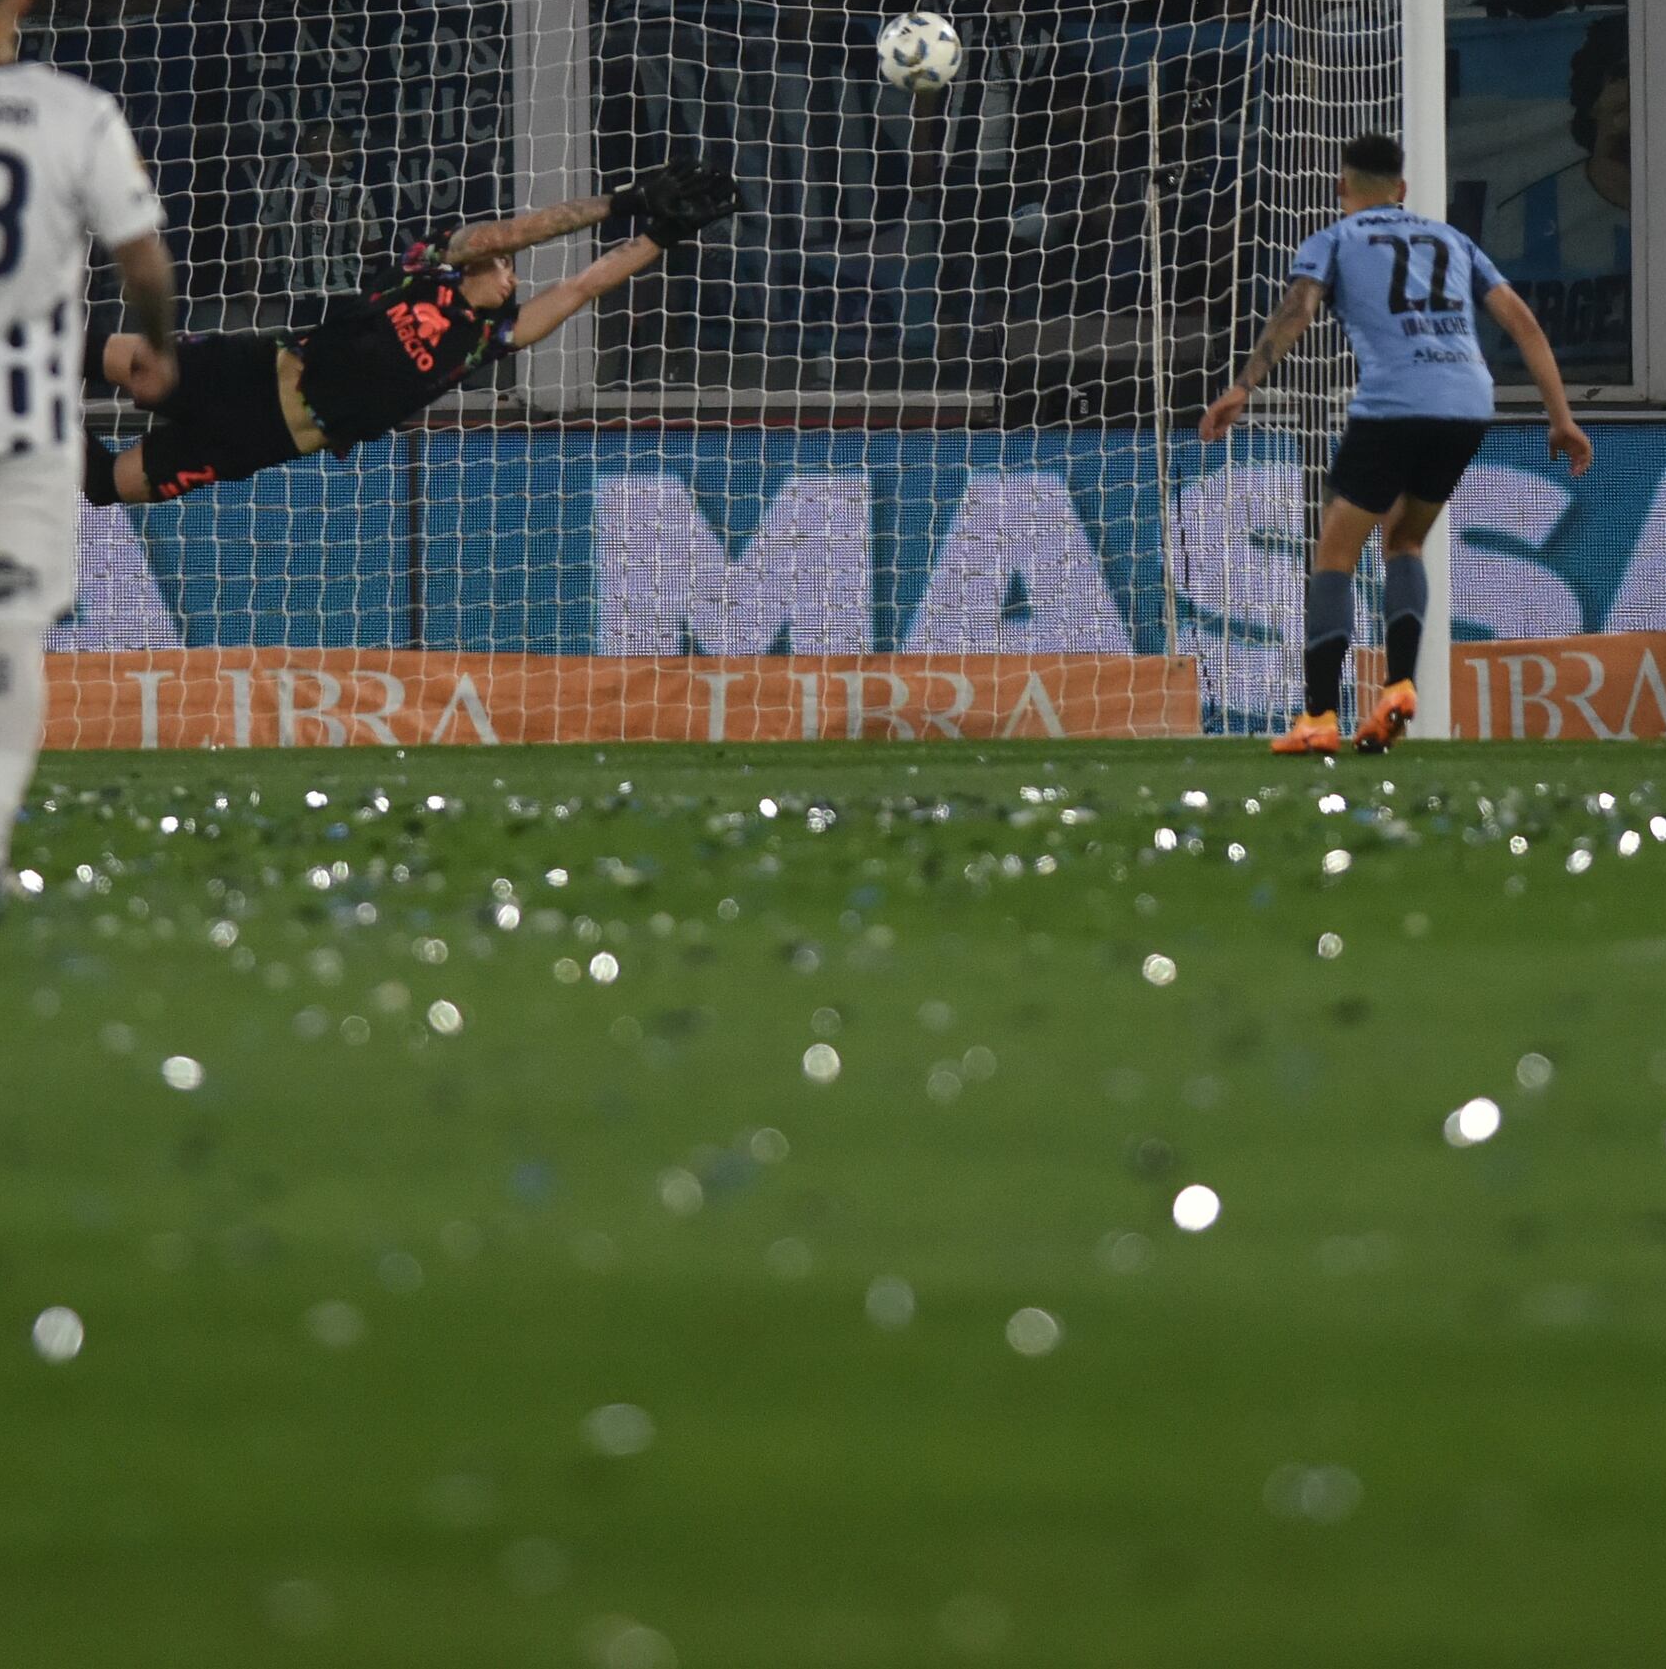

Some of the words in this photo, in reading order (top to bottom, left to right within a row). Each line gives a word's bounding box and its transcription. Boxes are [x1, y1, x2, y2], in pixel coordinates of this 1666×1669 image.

[388, 23, 511, 78] COS
[1367, 234, 1465, 316] 22
[386, 301, 435, 373] Macro
[126, 666, 501, 748] LIBRA
[695, 670, 1069, 744] LIBRA
